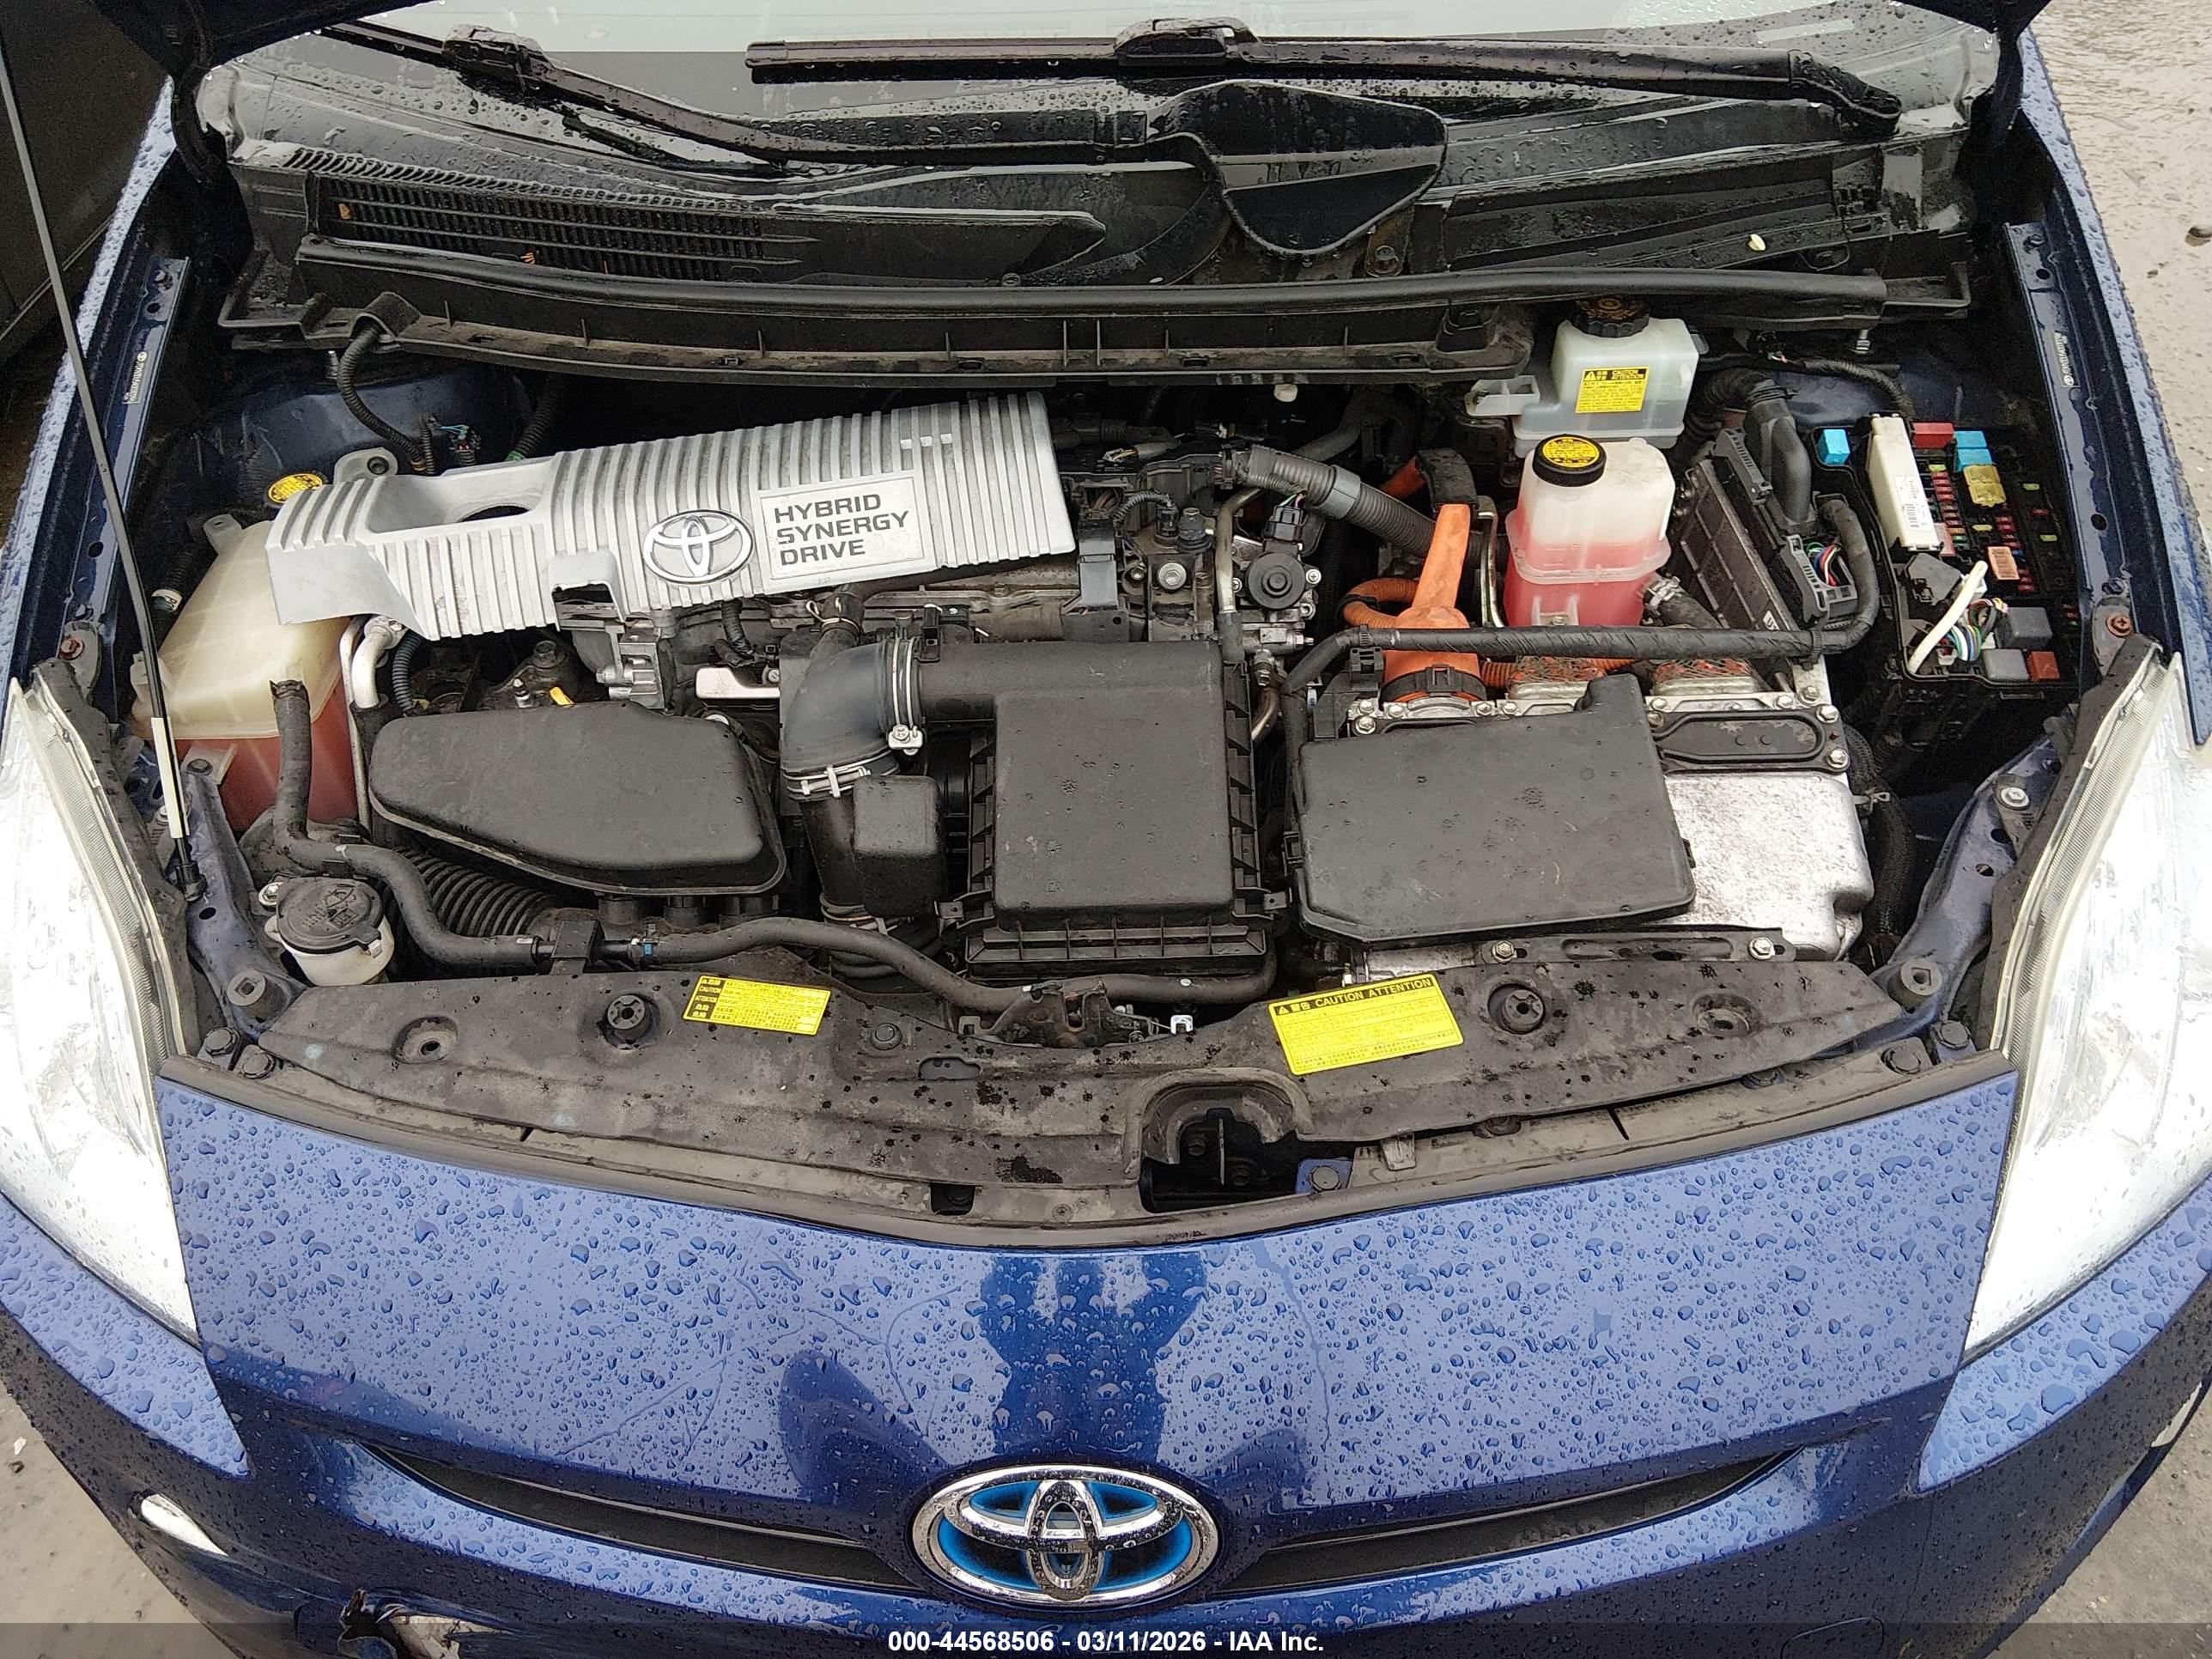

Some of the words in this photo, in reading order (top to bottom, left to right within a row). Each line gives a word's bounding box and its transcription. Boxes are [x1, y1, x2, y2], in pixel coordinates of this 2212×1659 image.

[775, 494, 881, 524] HYBRID
[776, 510, 909, 545] SYNERGY
[781, 539, 866, 565] DRIVE
[699, 985, 721, 994] CAUTION
[1315, 991, 1364, 1008] CAUTION
[1369, 978, 1432, 998] ATTENTION
